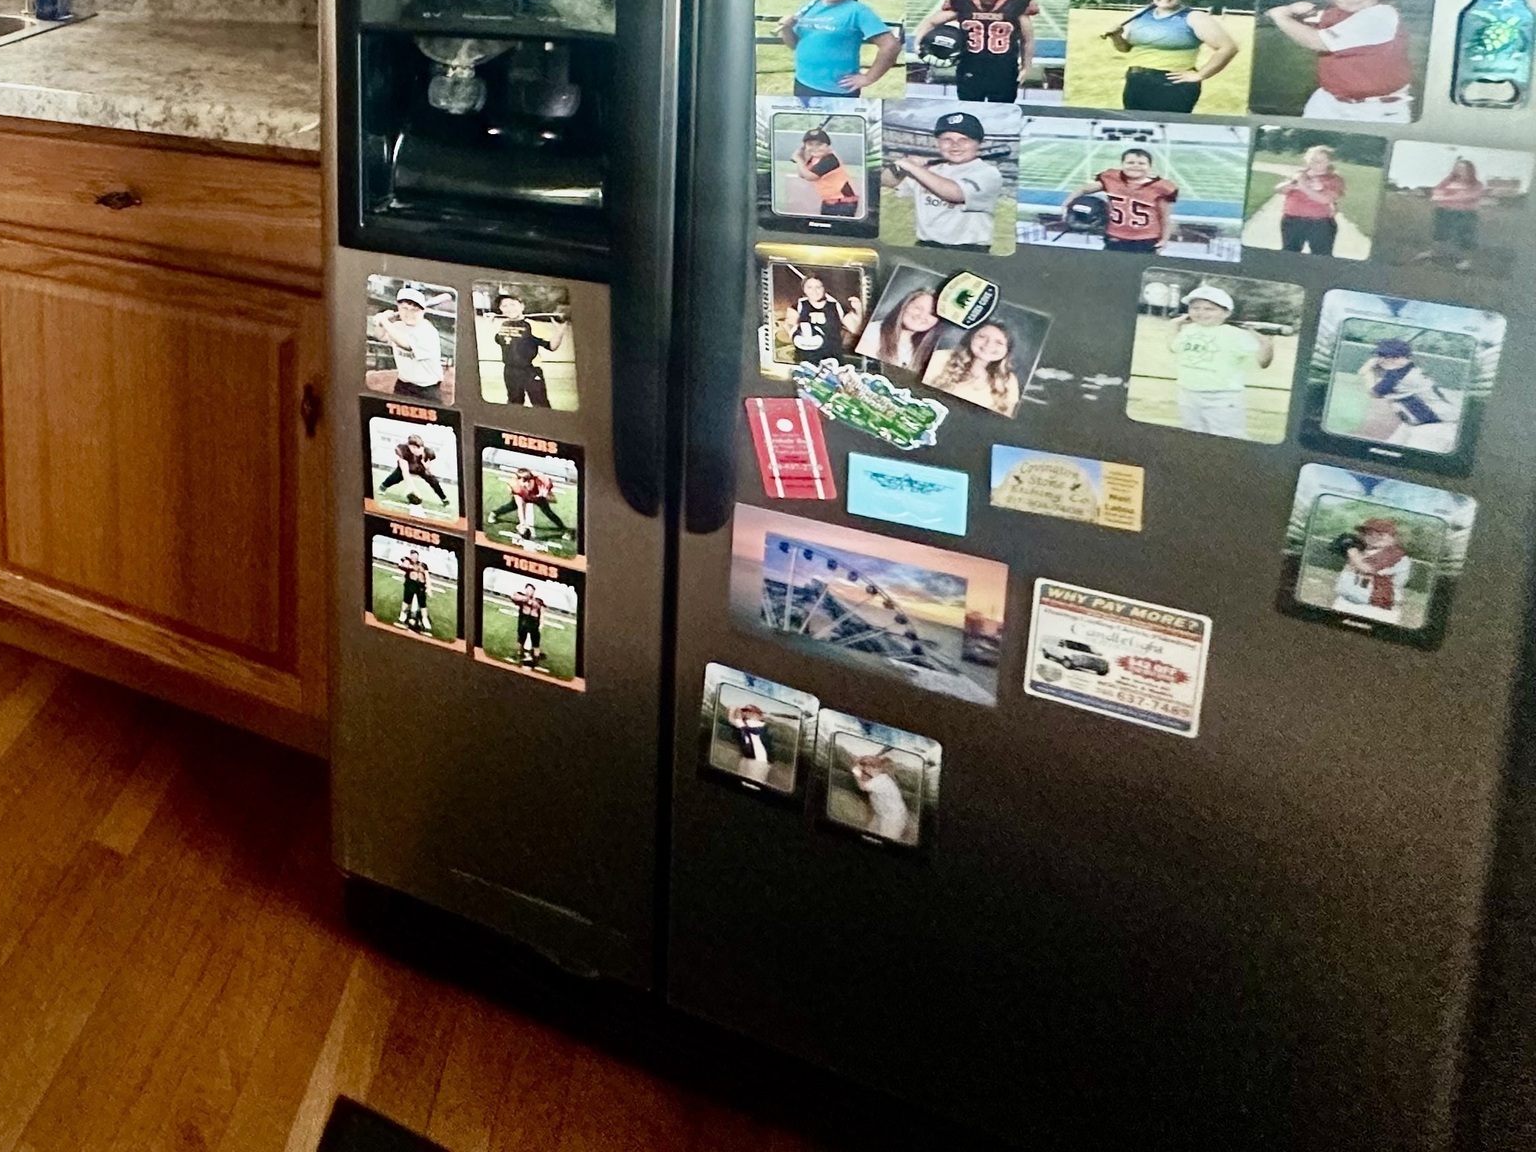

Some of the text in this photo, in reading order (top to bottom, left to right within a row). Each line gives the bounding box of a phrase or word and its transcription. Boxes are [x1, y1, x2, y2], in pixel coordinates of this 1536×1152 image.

[962, 19, 1014, 54] 38
[1107, 194, 1150, 229] 55
[386, 403, 437, 422] TIGERS
[501, 432, 558, 454] TIGERS
[390, 522, 441, 546] TIGERS
[502, 554, 558, 579] TIGERS
[1047, 586, 1200, 630] WHY PAY MORE?
